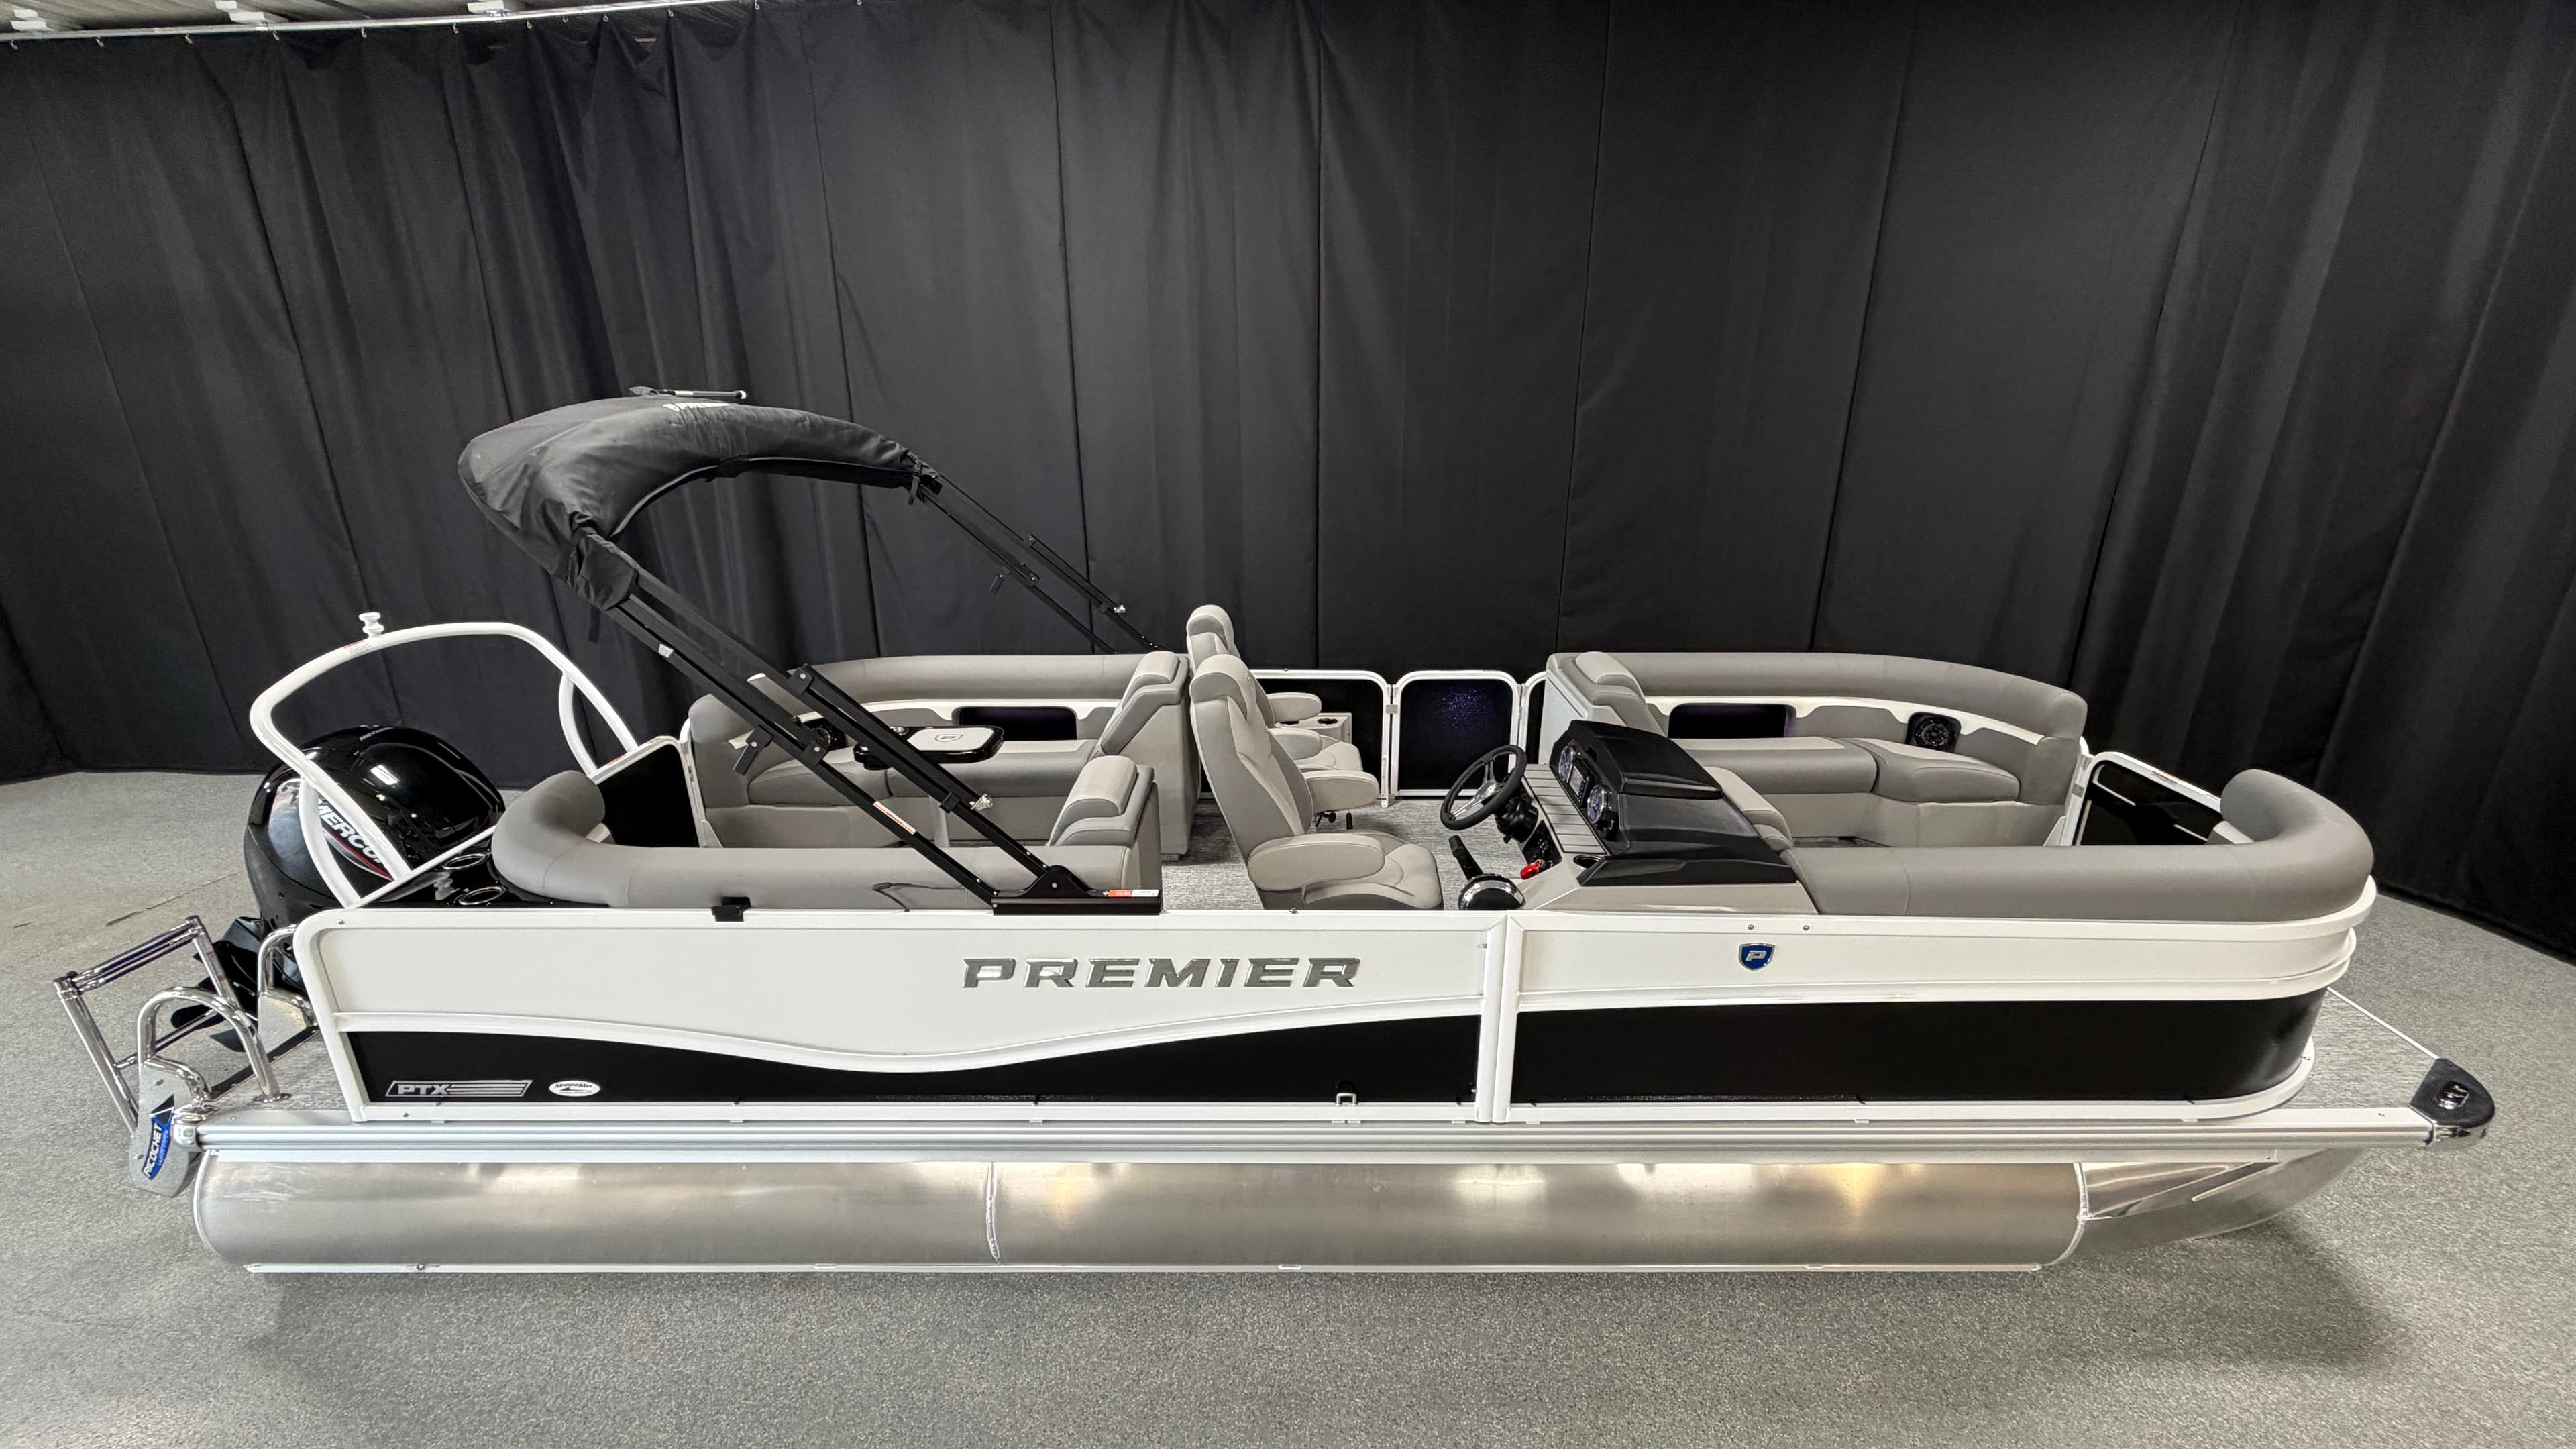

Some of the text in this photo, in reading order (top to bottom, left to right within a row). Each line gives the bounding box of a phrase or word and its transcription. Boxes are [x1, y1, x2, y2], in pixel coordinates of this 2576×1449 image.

[1746, 950, 1766, 961] P
[961, 957, 1362, 988] PREMIER
[397, 1083, 451, 1095] PTX
[143, 1123, 162, 1178] RICOCHET
